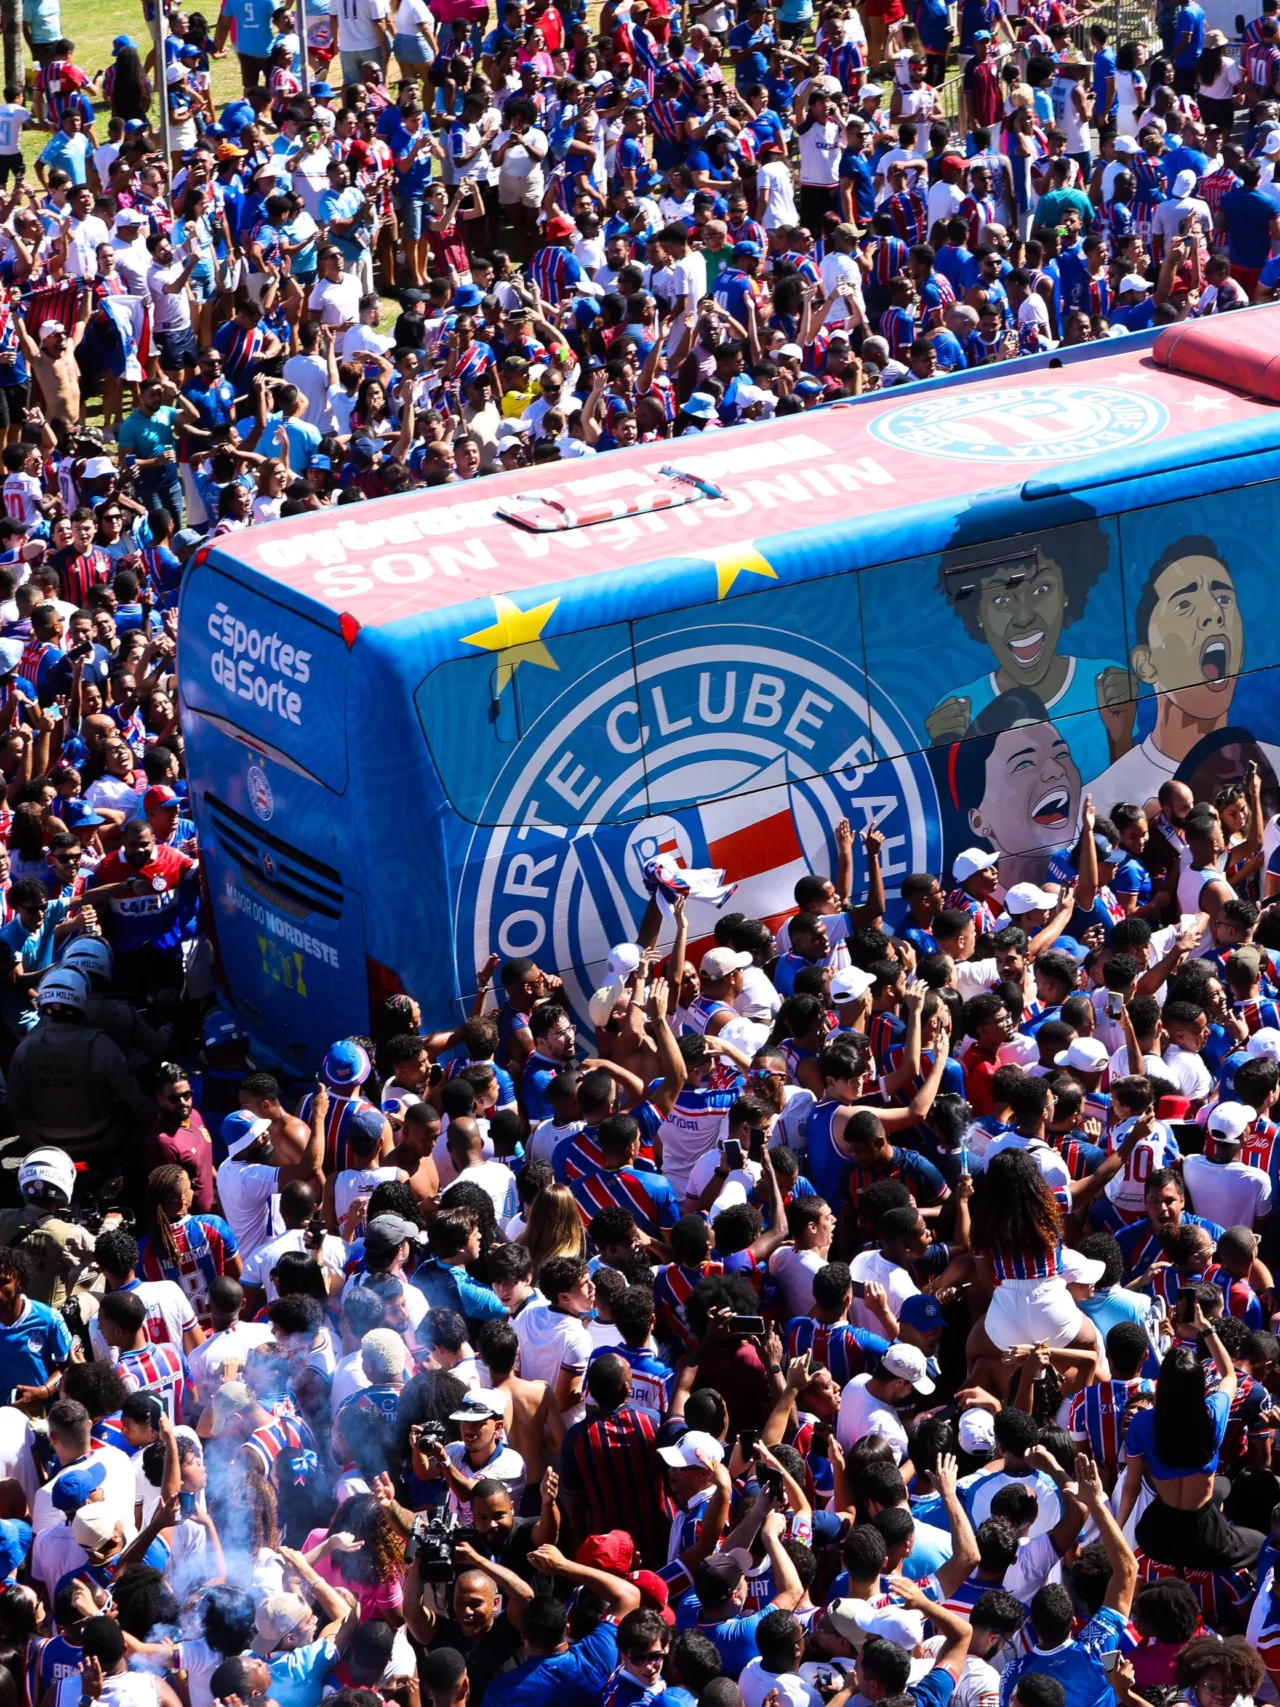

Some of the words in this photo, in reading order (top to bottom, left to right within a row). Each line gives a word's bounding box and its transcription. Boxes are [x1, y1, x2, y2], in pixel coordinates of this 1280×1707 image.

[1082, 391, 1138, 430] CLUBE
[1009, 430, 1120, 457] BAHIA
[313, 536, 499, 598] NOS
[208, 601, 312, 684] Esportes
[606, 670, 834, 754] CLUBE
[225, 882, 252, 917] MAIOR
[253, 904, 265, 925] DO
[265, 910, 339, 969] NORDESTE
[56, 991, 80, 1004] MILITAR
[1122, 1144, 1155, 1183] 10
